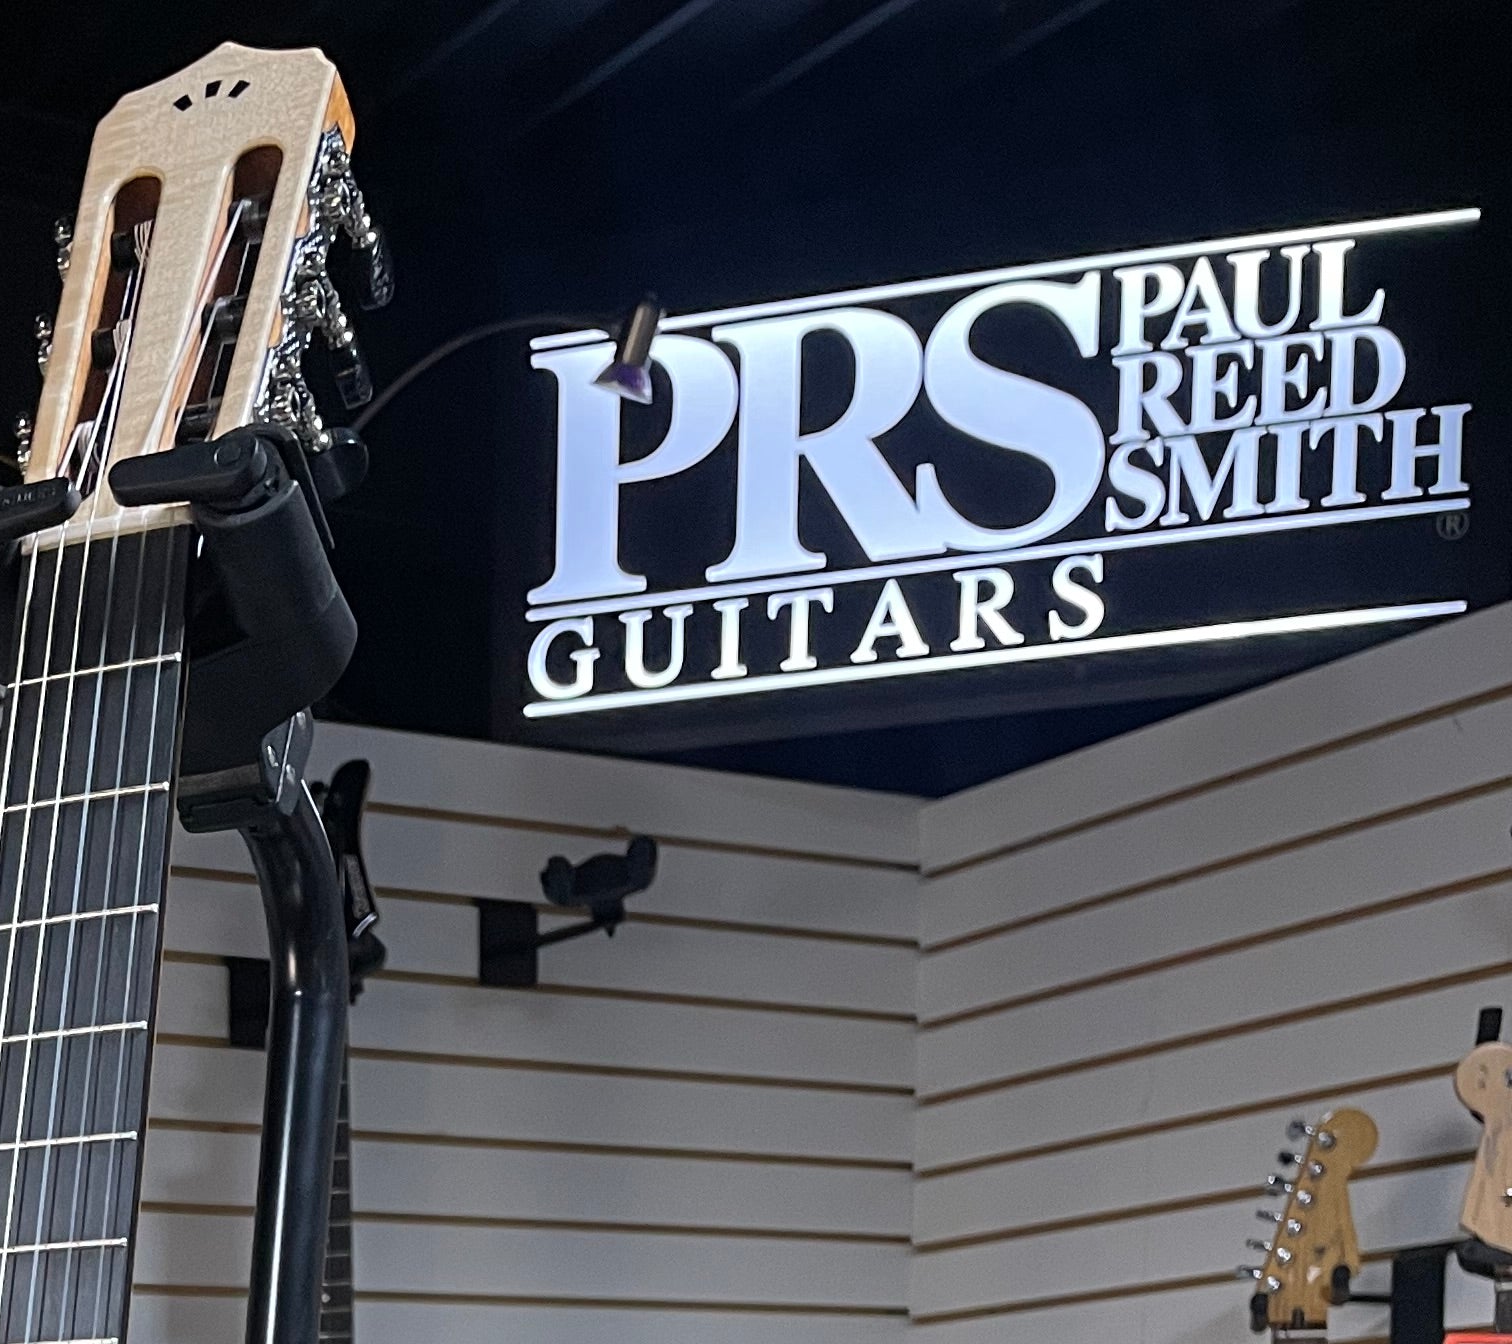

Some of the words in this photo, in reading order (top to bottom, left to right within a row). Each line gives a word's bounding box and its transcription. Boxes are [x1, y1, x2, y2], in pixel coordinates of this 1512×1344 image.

[1112, 240, 1384, 356] PAUL
[526, 272, 1105, 604] PRS
[1110, 325, 1406, 444] REED
[1105, 403, 1471, 531] SMITH
[526, 554, 1106, 700] GUITARS
